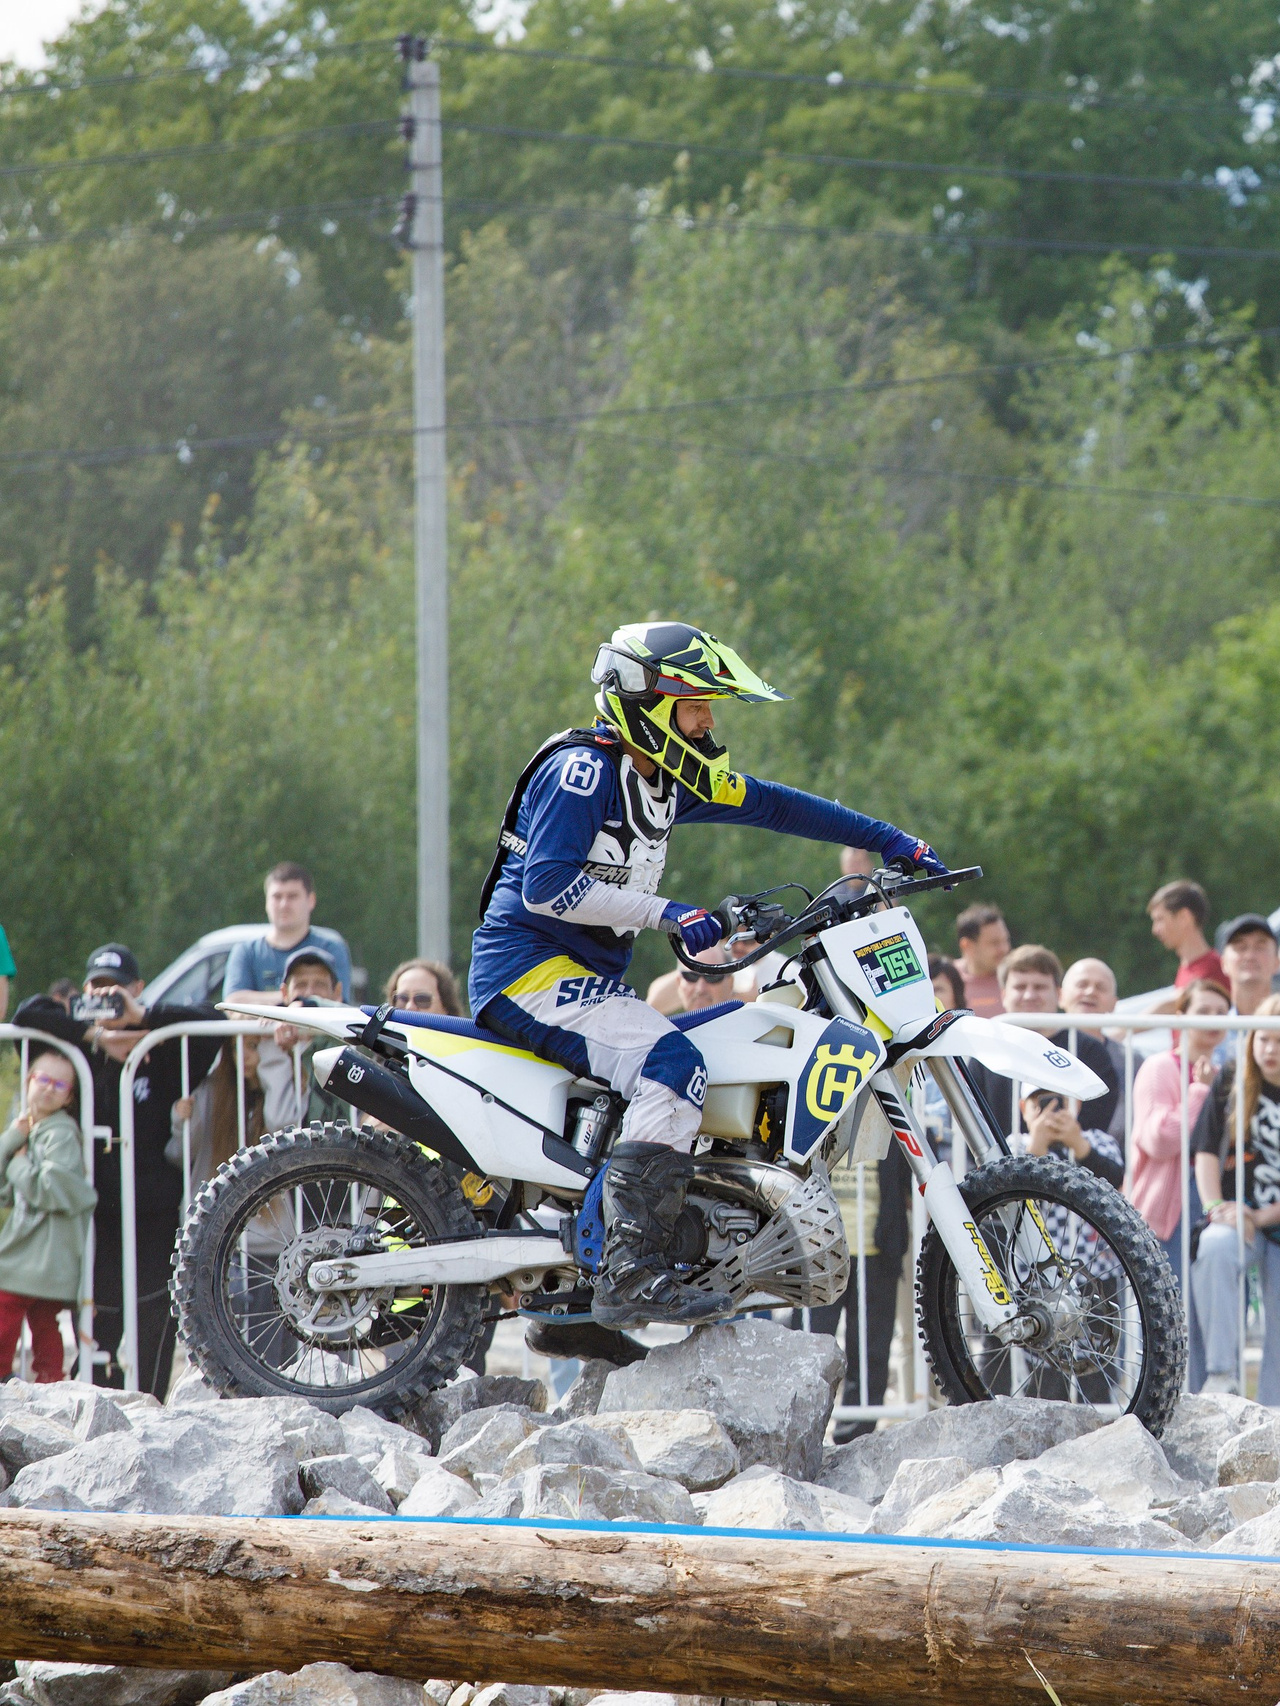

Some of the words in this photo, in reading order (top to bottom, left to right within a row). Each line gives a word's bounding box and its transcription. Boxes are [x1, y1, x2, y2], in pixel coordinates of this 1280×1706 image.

[551, 876, 591, 917] SHO
[881, 946, 920, 980] 154
[556, 976, 635, 1008] SHO
[836, 1017, 869, 1035] Husqvarna
